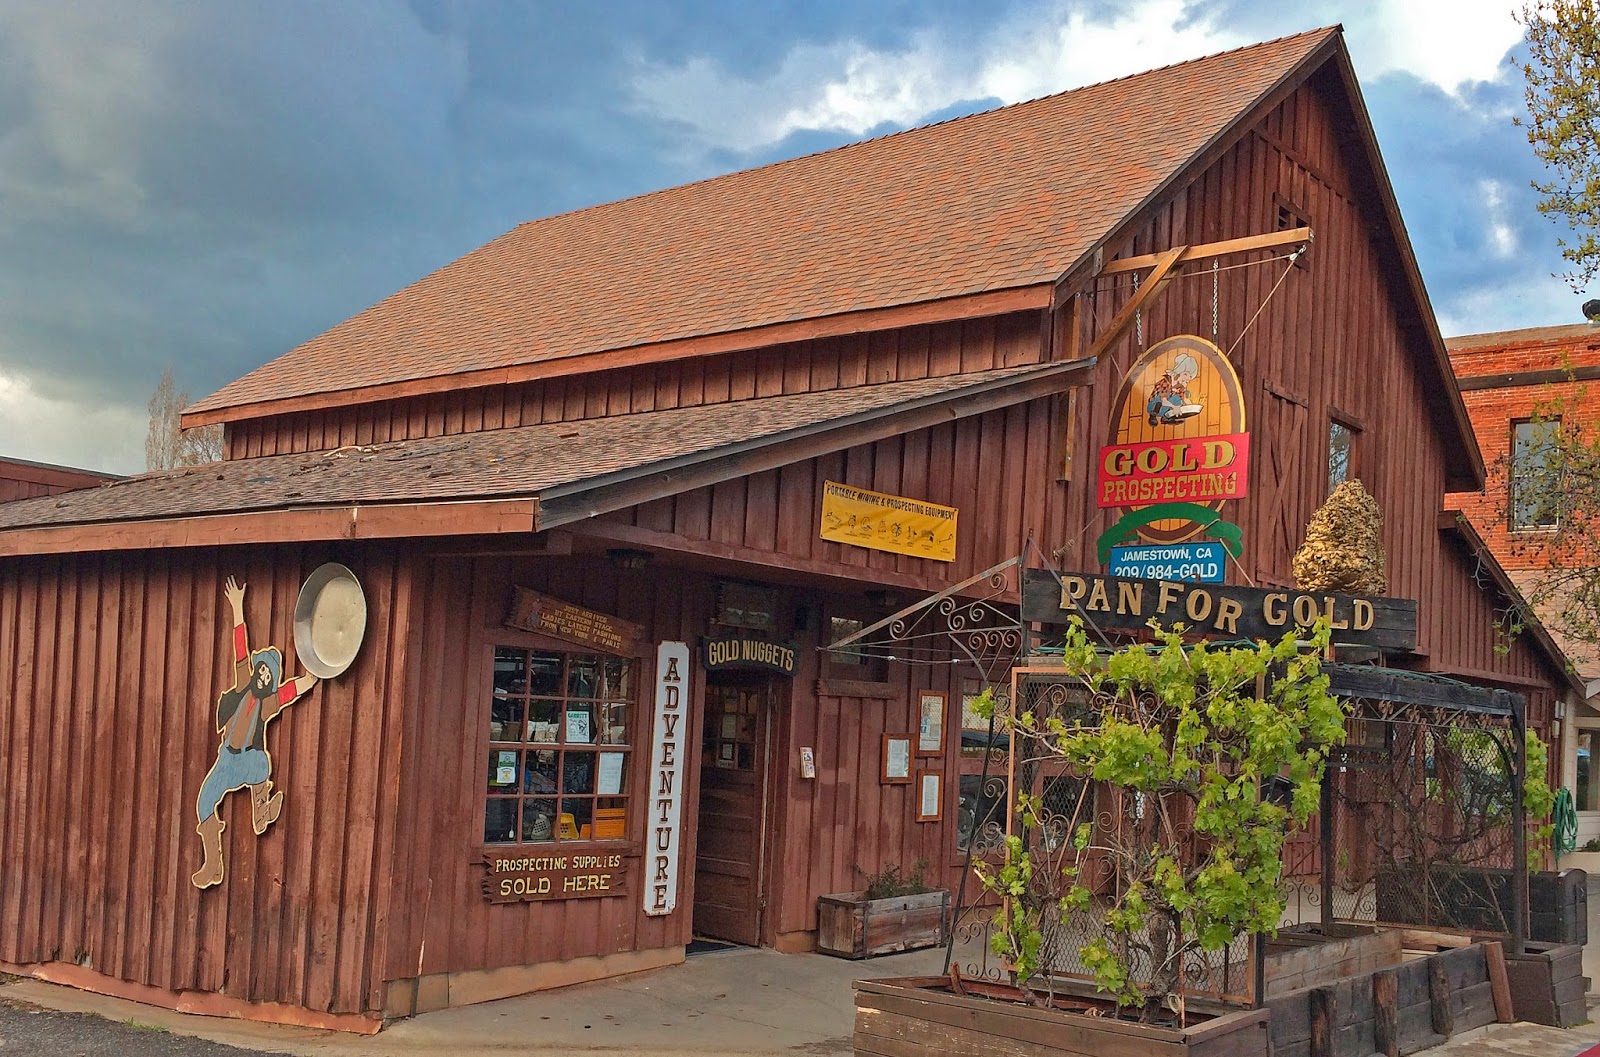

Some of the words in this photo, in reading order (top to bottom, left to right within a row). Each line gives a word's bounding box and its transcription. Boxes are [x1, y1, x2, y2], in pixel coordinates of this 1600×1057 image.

[1104, 440, 1236, 477] GOLD
[1103, 472, 1237, 502] PROSPECTING
[826, 484, 857, 501] PORTABLE
[857, 492, 879, 506] MINING
[887, 498, 924, 515] PROSPECTING
[925, 506, 955, 521] EQUIPMENT
[1121, 548, 1192, 562] JAMESTOWN,
[1195, 547, 1212, 559] CA
[1115, 563, 1218, 580] 209/984-GOLD
[1059, 575, 1143, 616] PAN
[1156, 581, 1243, 634] FOR
[1263, 592, 1375, 631] GOLD
[541, 620, 557, 630] FROM
[574, 630, 589, 640] YORK
[602, 638, 620, 648] PARIS
[542, 613, 565, 625] LADIES
[568, 622, 590, 632] LATEST
[592, 629, 621, 642] FASHIONS
[565, 614, 592, 625] EASTERN
[708, 639, 740, 666] GOLD
[742, 640, 795, 672] NUGGETS
[653, 657, 681, 910] ADVENTURE
[495, 857, 567, 873] PROSPECTING
[500, 877, 551, 896] SOLD
[563, 874, 611, 892] HERE
